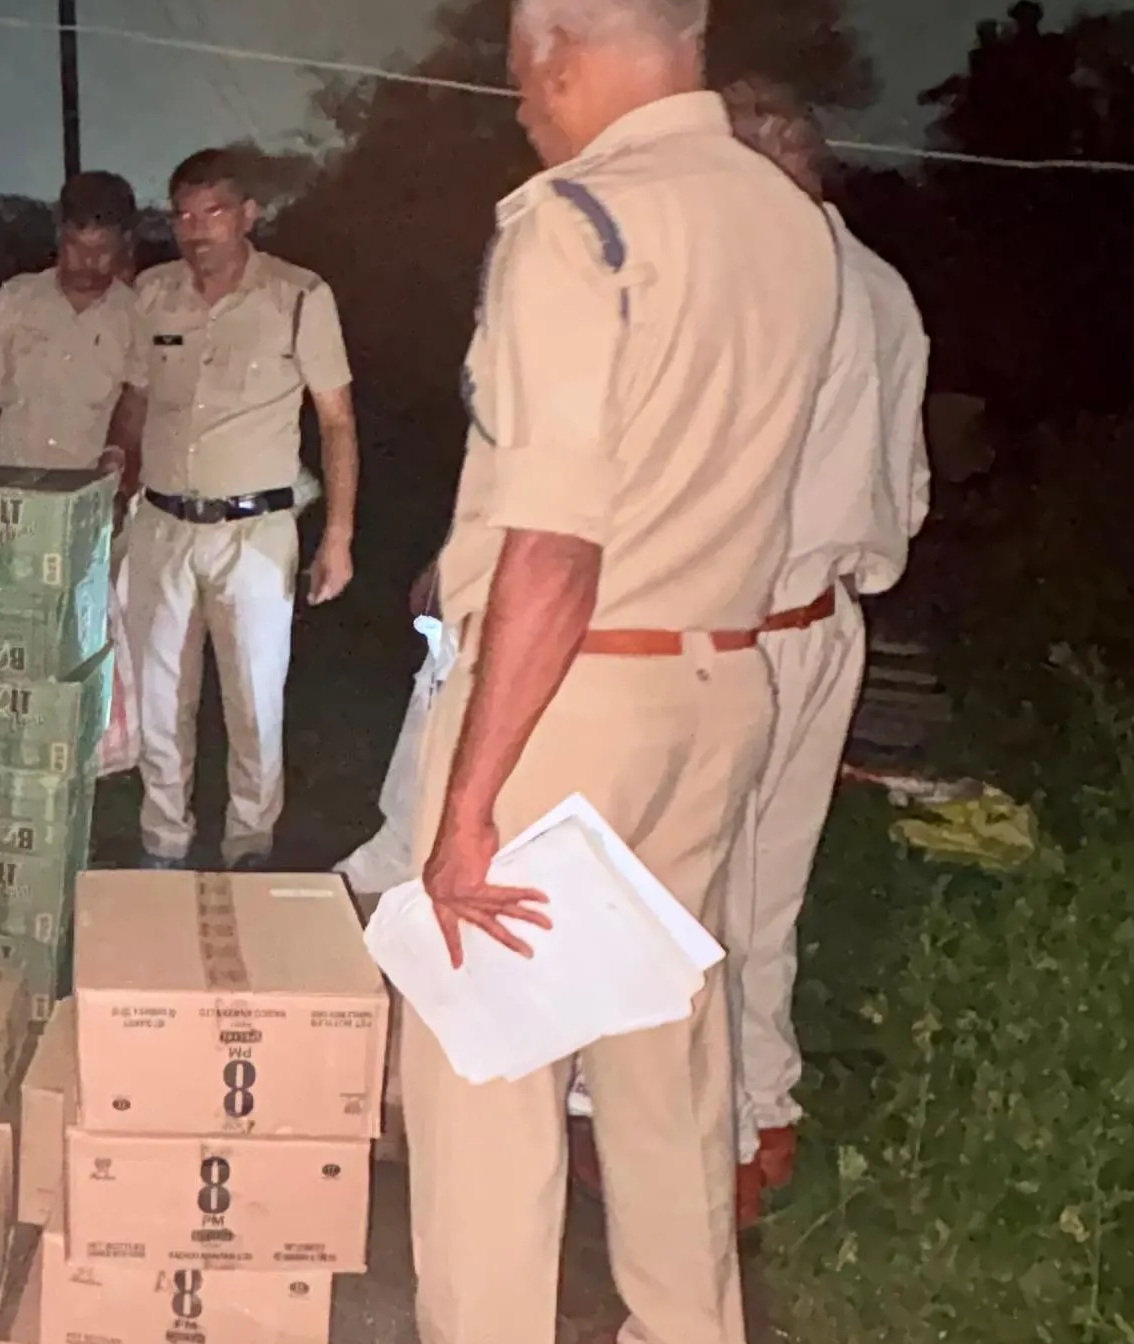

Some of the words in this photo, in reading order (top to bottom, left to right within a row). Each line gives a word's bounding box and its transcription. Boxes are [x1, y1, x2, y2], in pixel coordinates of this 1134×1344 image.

[228, 1047, 252, 1058] PM
[222, 1059, 256, 1118] 8
[198, 1157, 231, 1214] 8
[172, 1269, 203, 1319] 8
